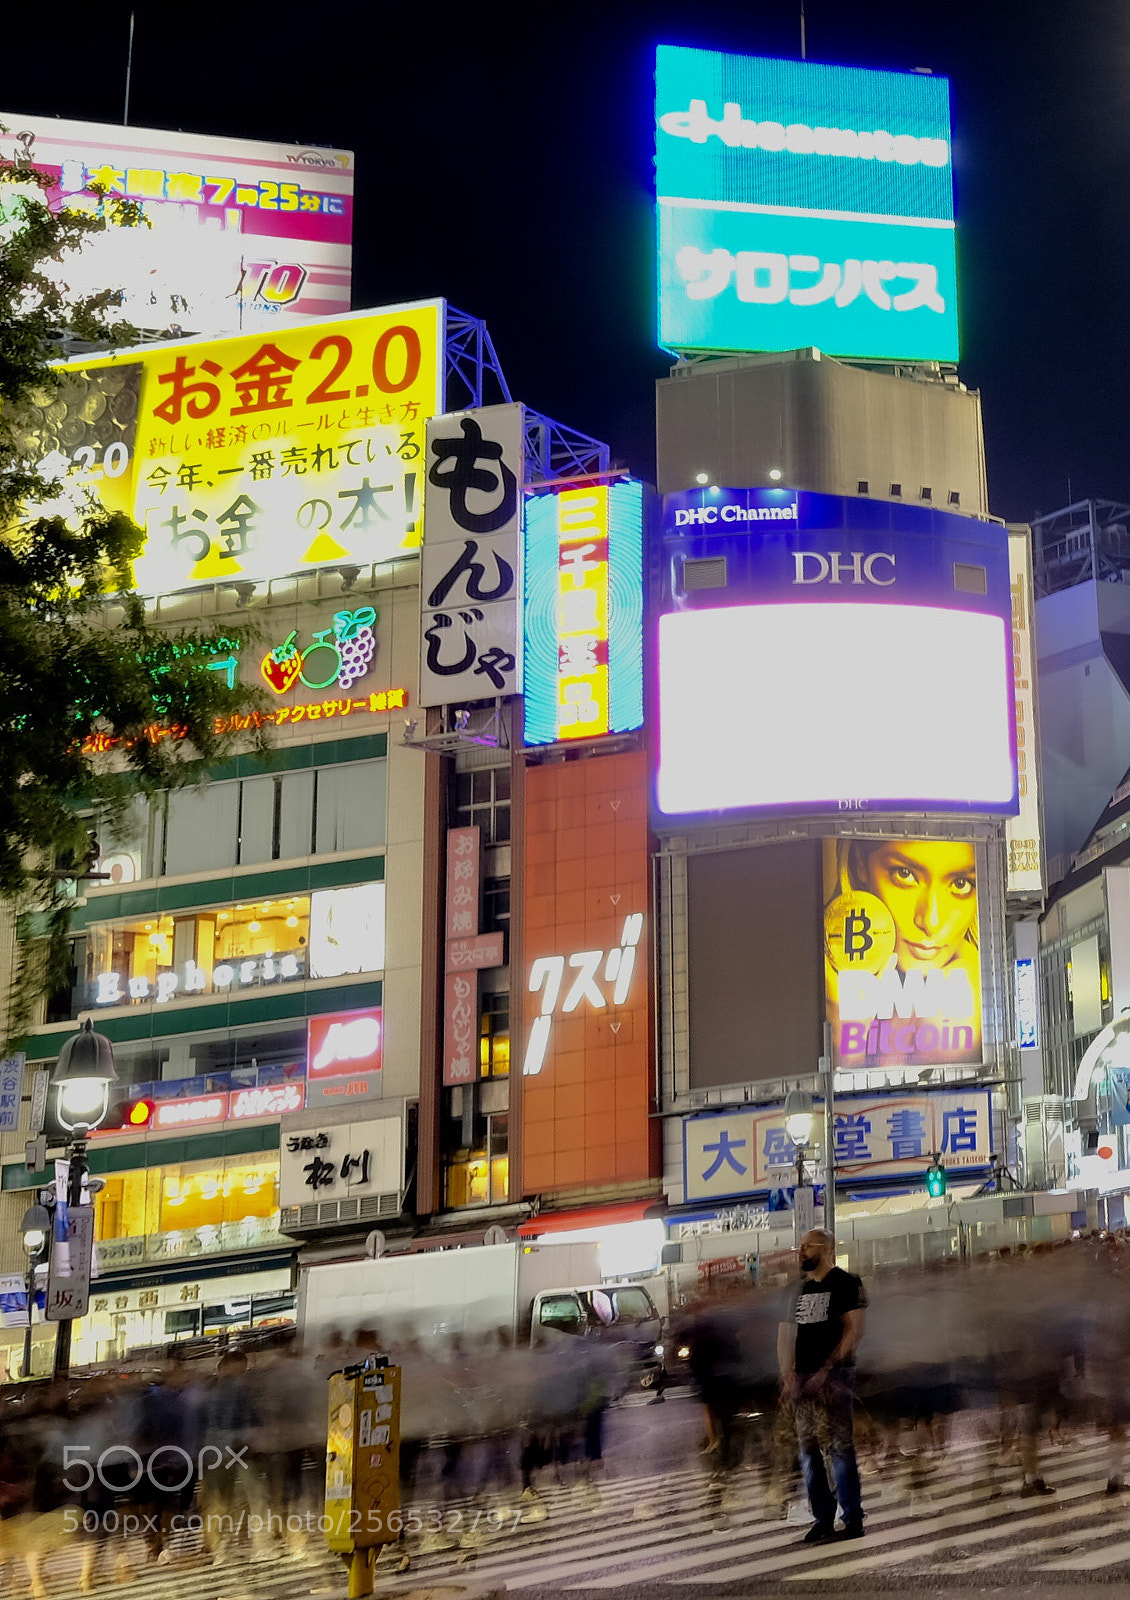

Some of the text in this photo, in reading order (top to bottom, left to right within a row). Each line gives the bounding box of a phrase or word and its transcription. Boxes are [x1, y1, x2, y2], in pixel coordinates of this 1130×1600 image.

[675, 246, 945, 314] サロンパス
[152, 326, 421, 426] お金2.0
[149, 400, 421, 457] 新しい経済のルールと生き方
[675, 504, 798, 526] DHC Channel
[425, 418, 517, 689] もんじゃ
[792, 551, 896, 586] DHC
[837, 798, 869, 810] DHC
[453, 835, 474, 932] お好み焼
[840, 1018, 974, 1056] Bitcoin
[346, 1080, 368, 1097] JTB
[702, 1107, 978, 1181] 大盛堂書店
[303, 1149, 370, 1190] 松川
